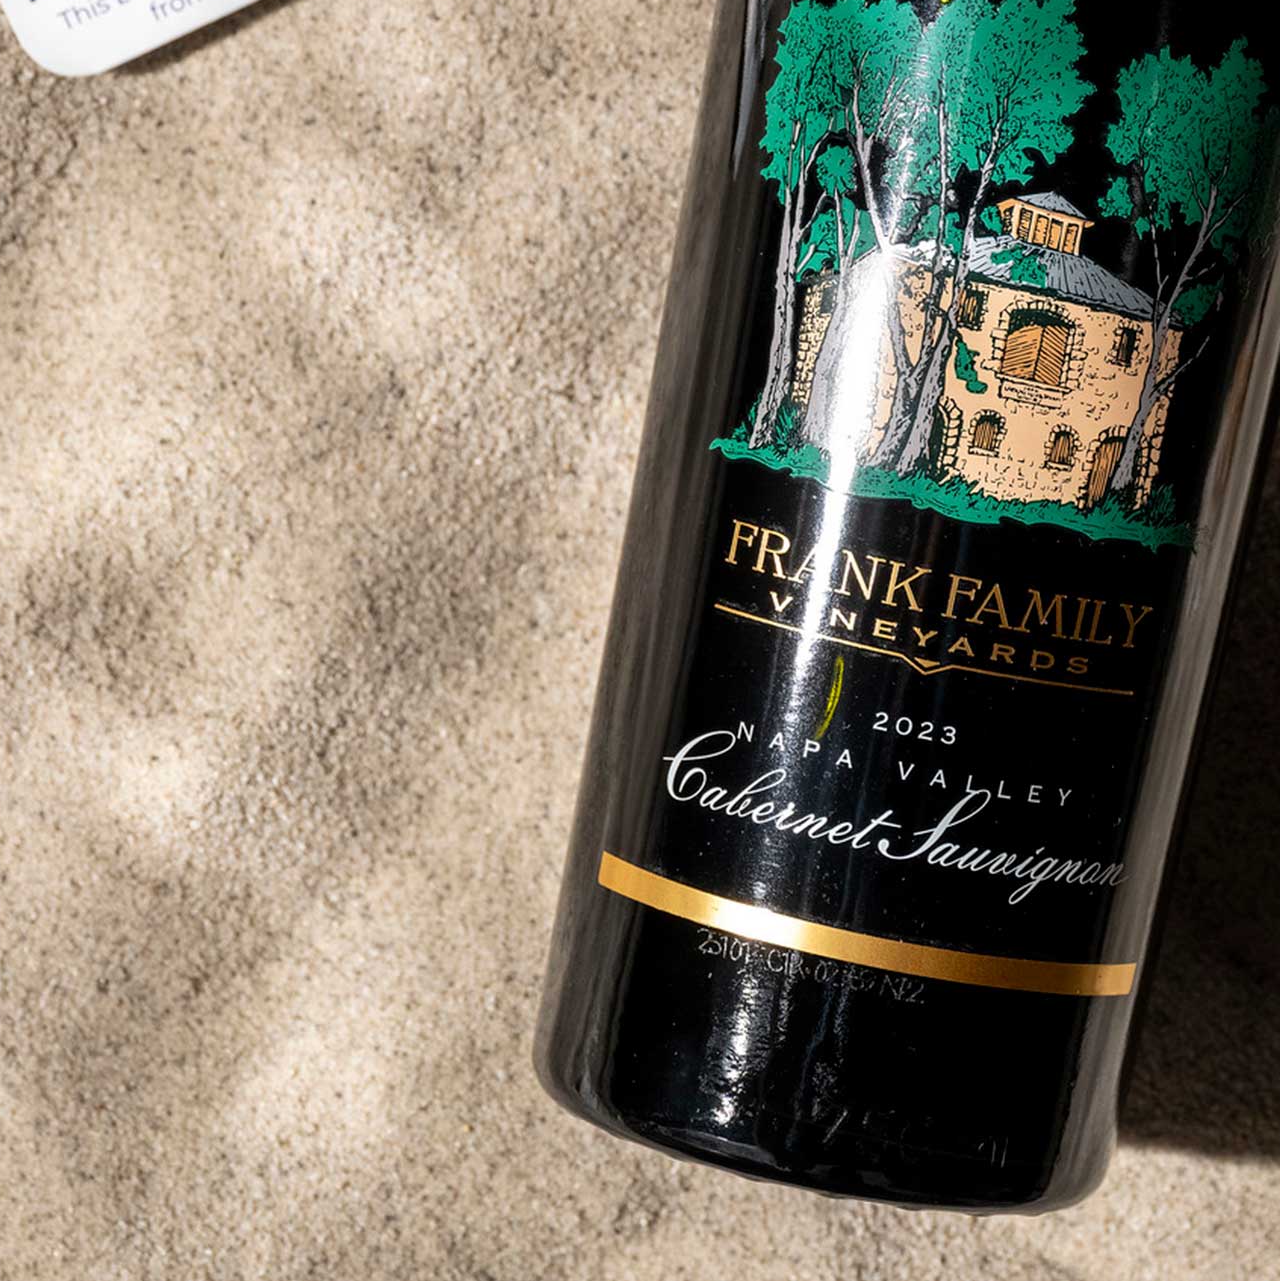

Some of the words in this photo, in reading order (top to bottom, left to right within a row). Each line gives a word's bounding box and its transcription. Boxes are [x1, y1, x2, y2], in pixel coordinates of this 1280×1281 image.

[770, 591, 1089, 675] VNEYARDS
[941, 573, 1153, 649] FAMILY
[737, 721, 853, 769] NAPA
[898, 760, 1072, 806] VALLEY
[873, 711, 957, 745] 2023
[663, 730, 901, 848] Cabernet
[878, 789, 1129, 905] Sauvignon
